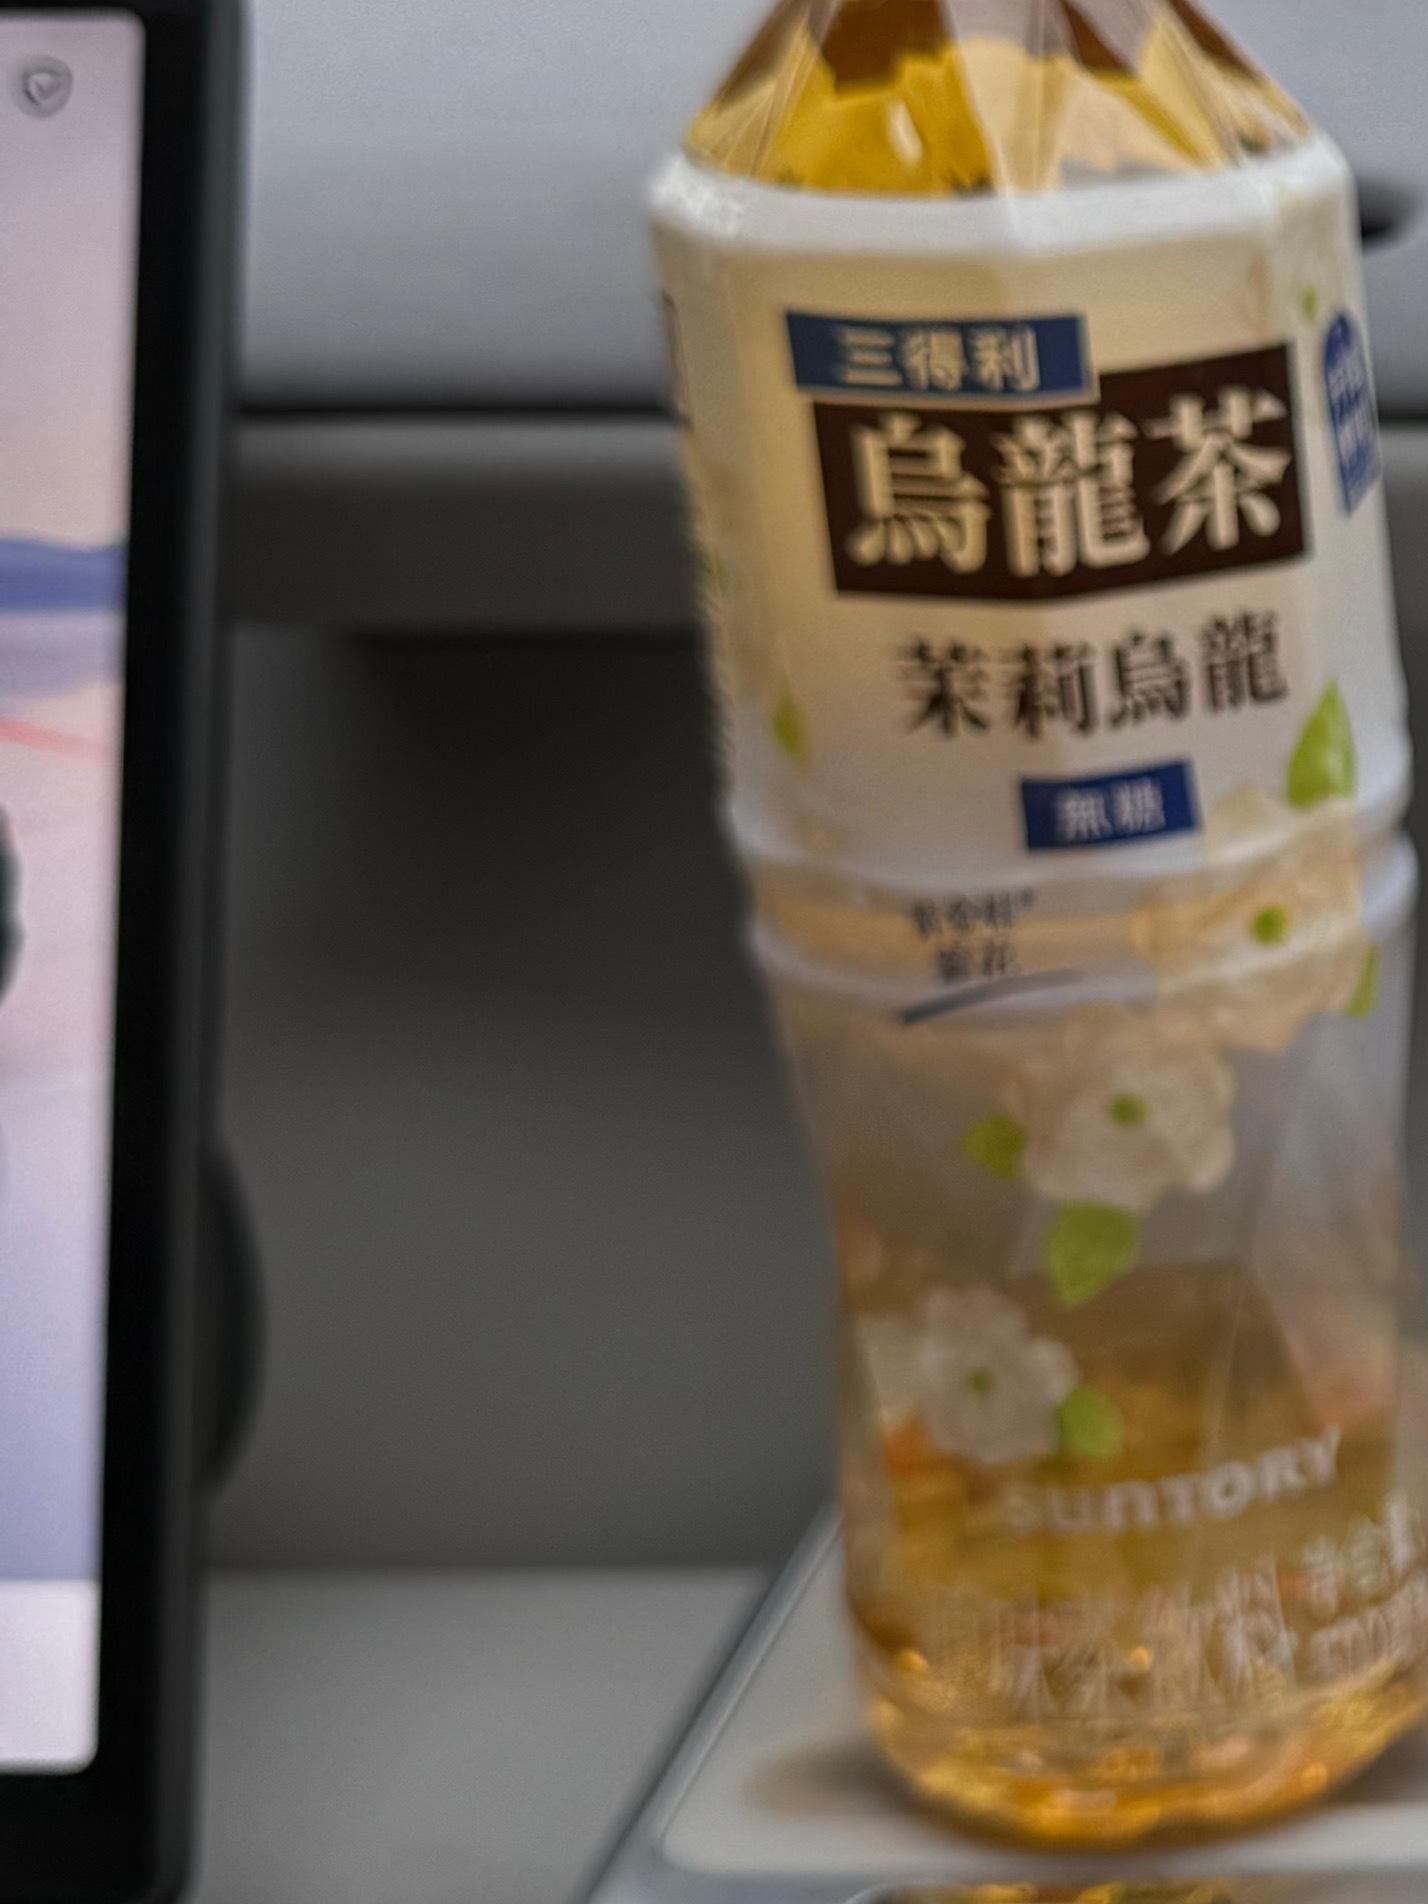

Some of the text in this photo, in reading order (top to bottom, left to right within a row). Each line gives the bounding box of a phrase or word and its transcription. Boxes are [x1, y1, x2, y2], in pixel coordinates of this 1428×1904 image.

[834, 325, 1040, 392] 三得利
[845, 387, 1291, 575] 烏龍茶
[898, 609, 1289, 740] 茉莉烏龍
